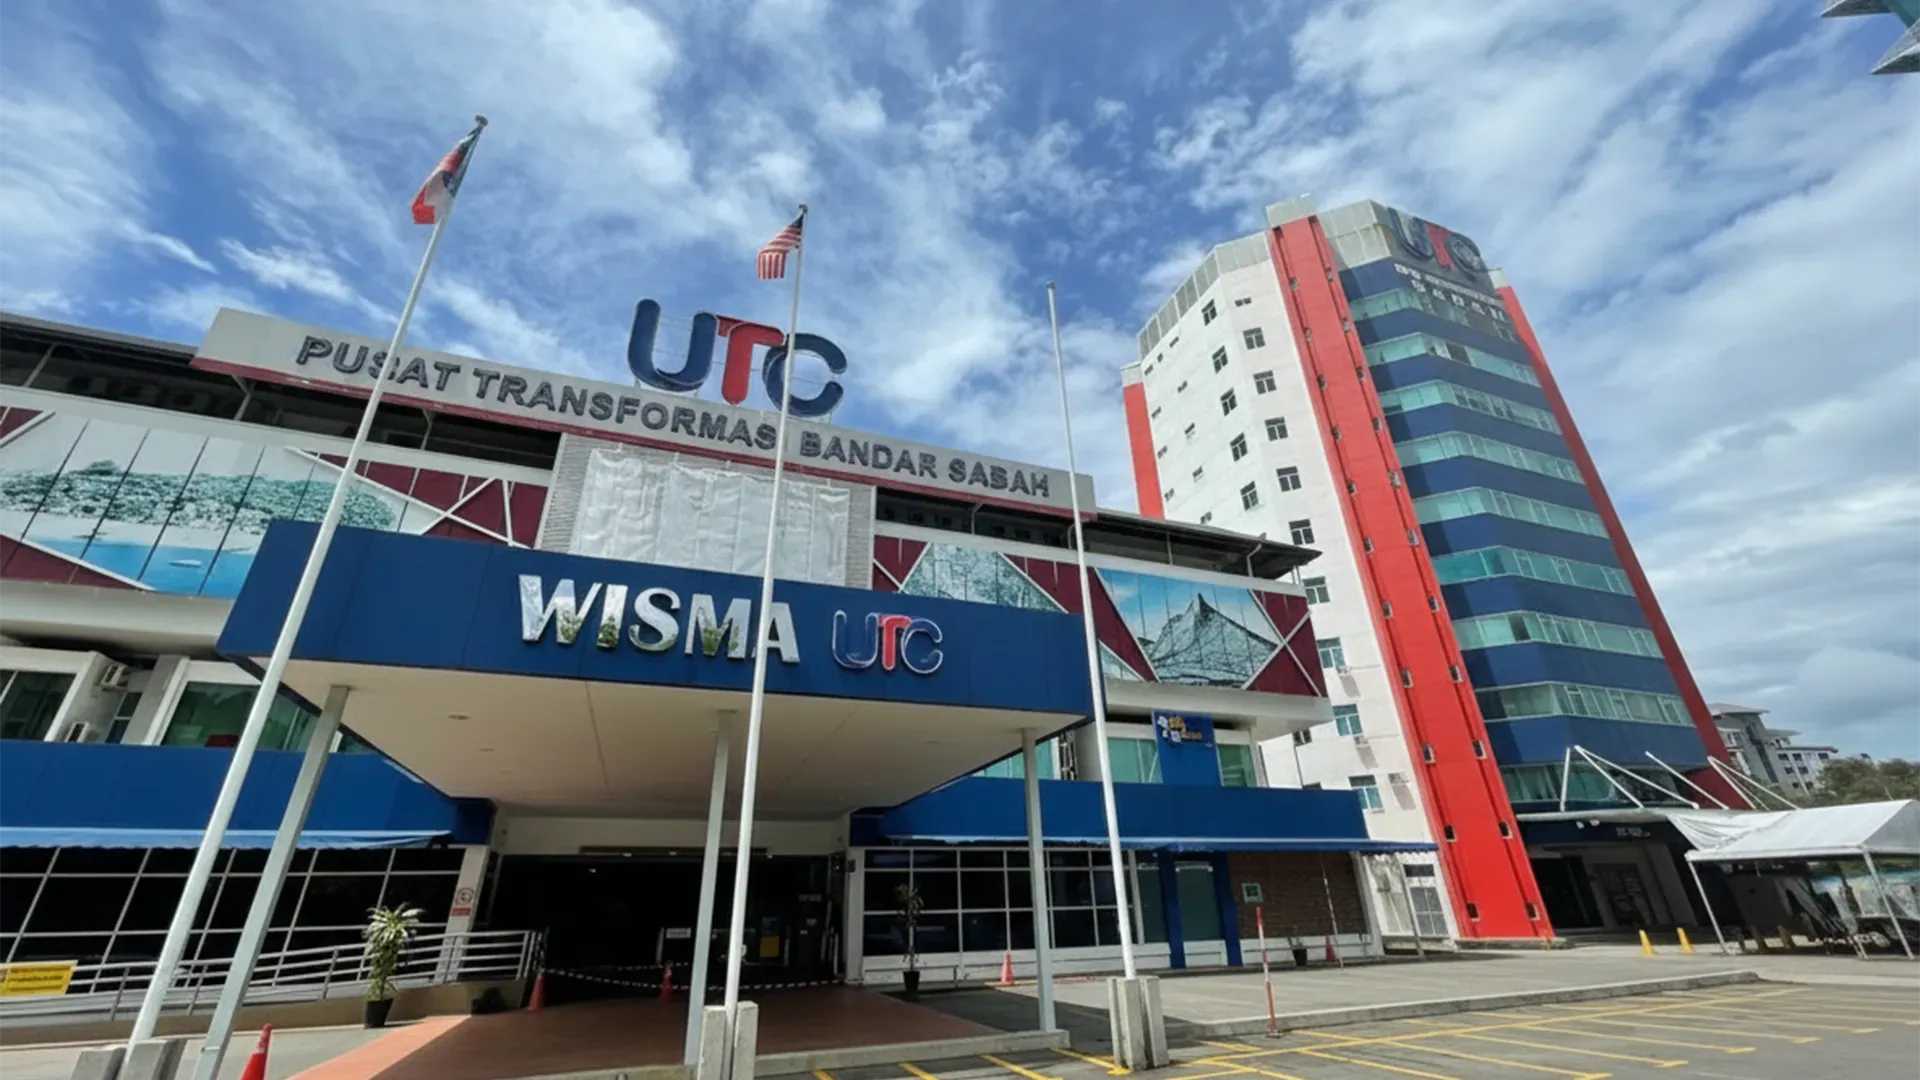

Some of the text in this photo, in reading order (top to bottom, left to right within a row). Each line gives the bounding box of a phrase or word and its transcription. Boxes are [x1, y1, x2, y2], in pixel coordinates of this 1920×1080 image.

[1387, 207, 1486, 281] UTC
[627, 298, 848, 417] UTC
[295, 335, 1050, 498] PUSAT TRANSFORMAS BANDAR SABAH
[518, 574, 944, 674] WISMA UTC
